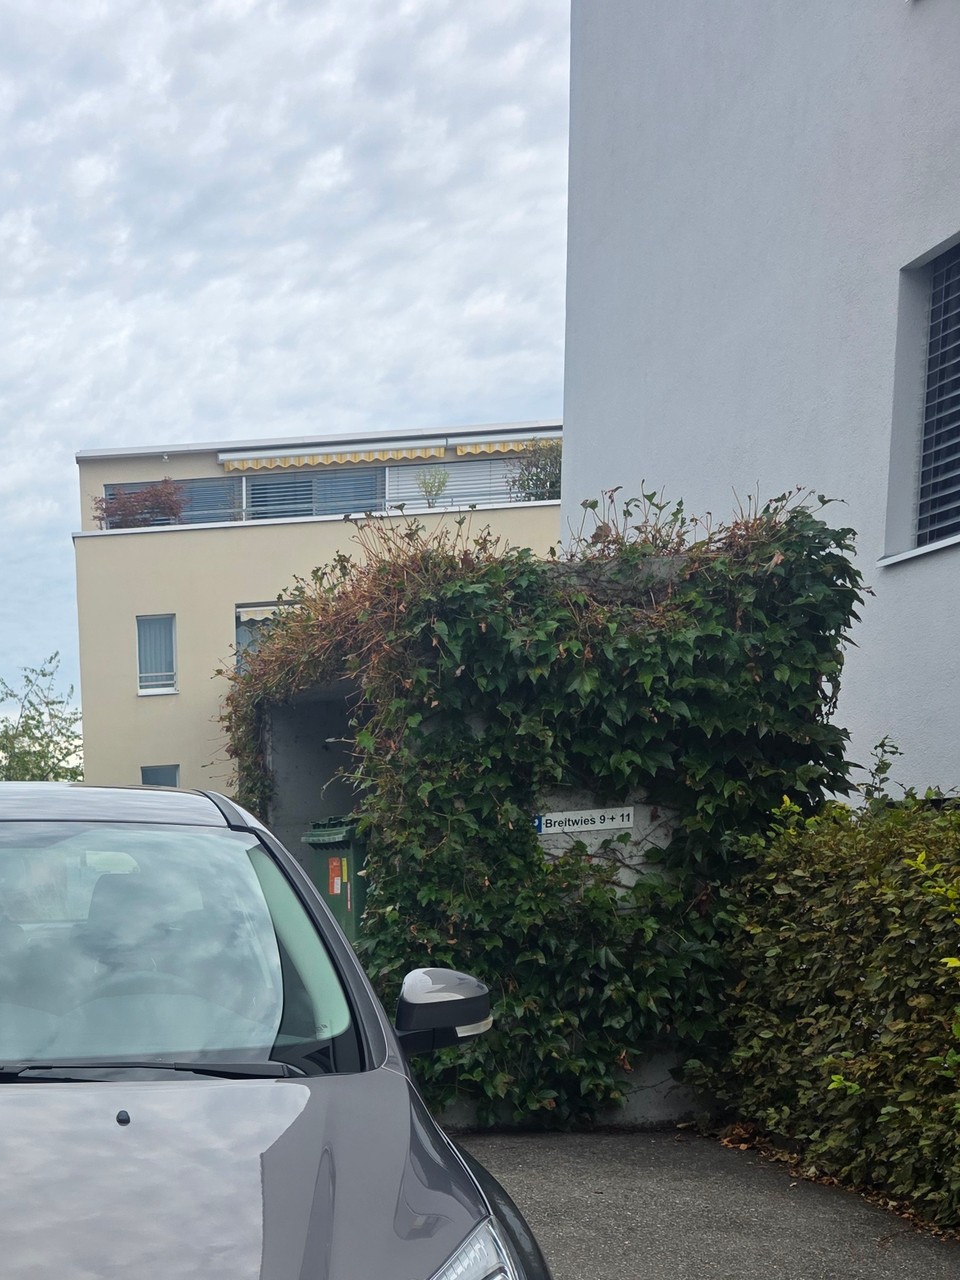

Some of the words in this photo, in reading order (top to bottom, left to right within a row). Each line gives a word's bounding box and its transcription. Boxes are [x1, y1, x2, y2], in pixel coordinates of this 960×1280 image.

[545, 816, 596, 829] Breitwies
[599, 814, 606, 824] 9
[610, 815, 616, 823] +
[620, 812, 631, 823] 11
